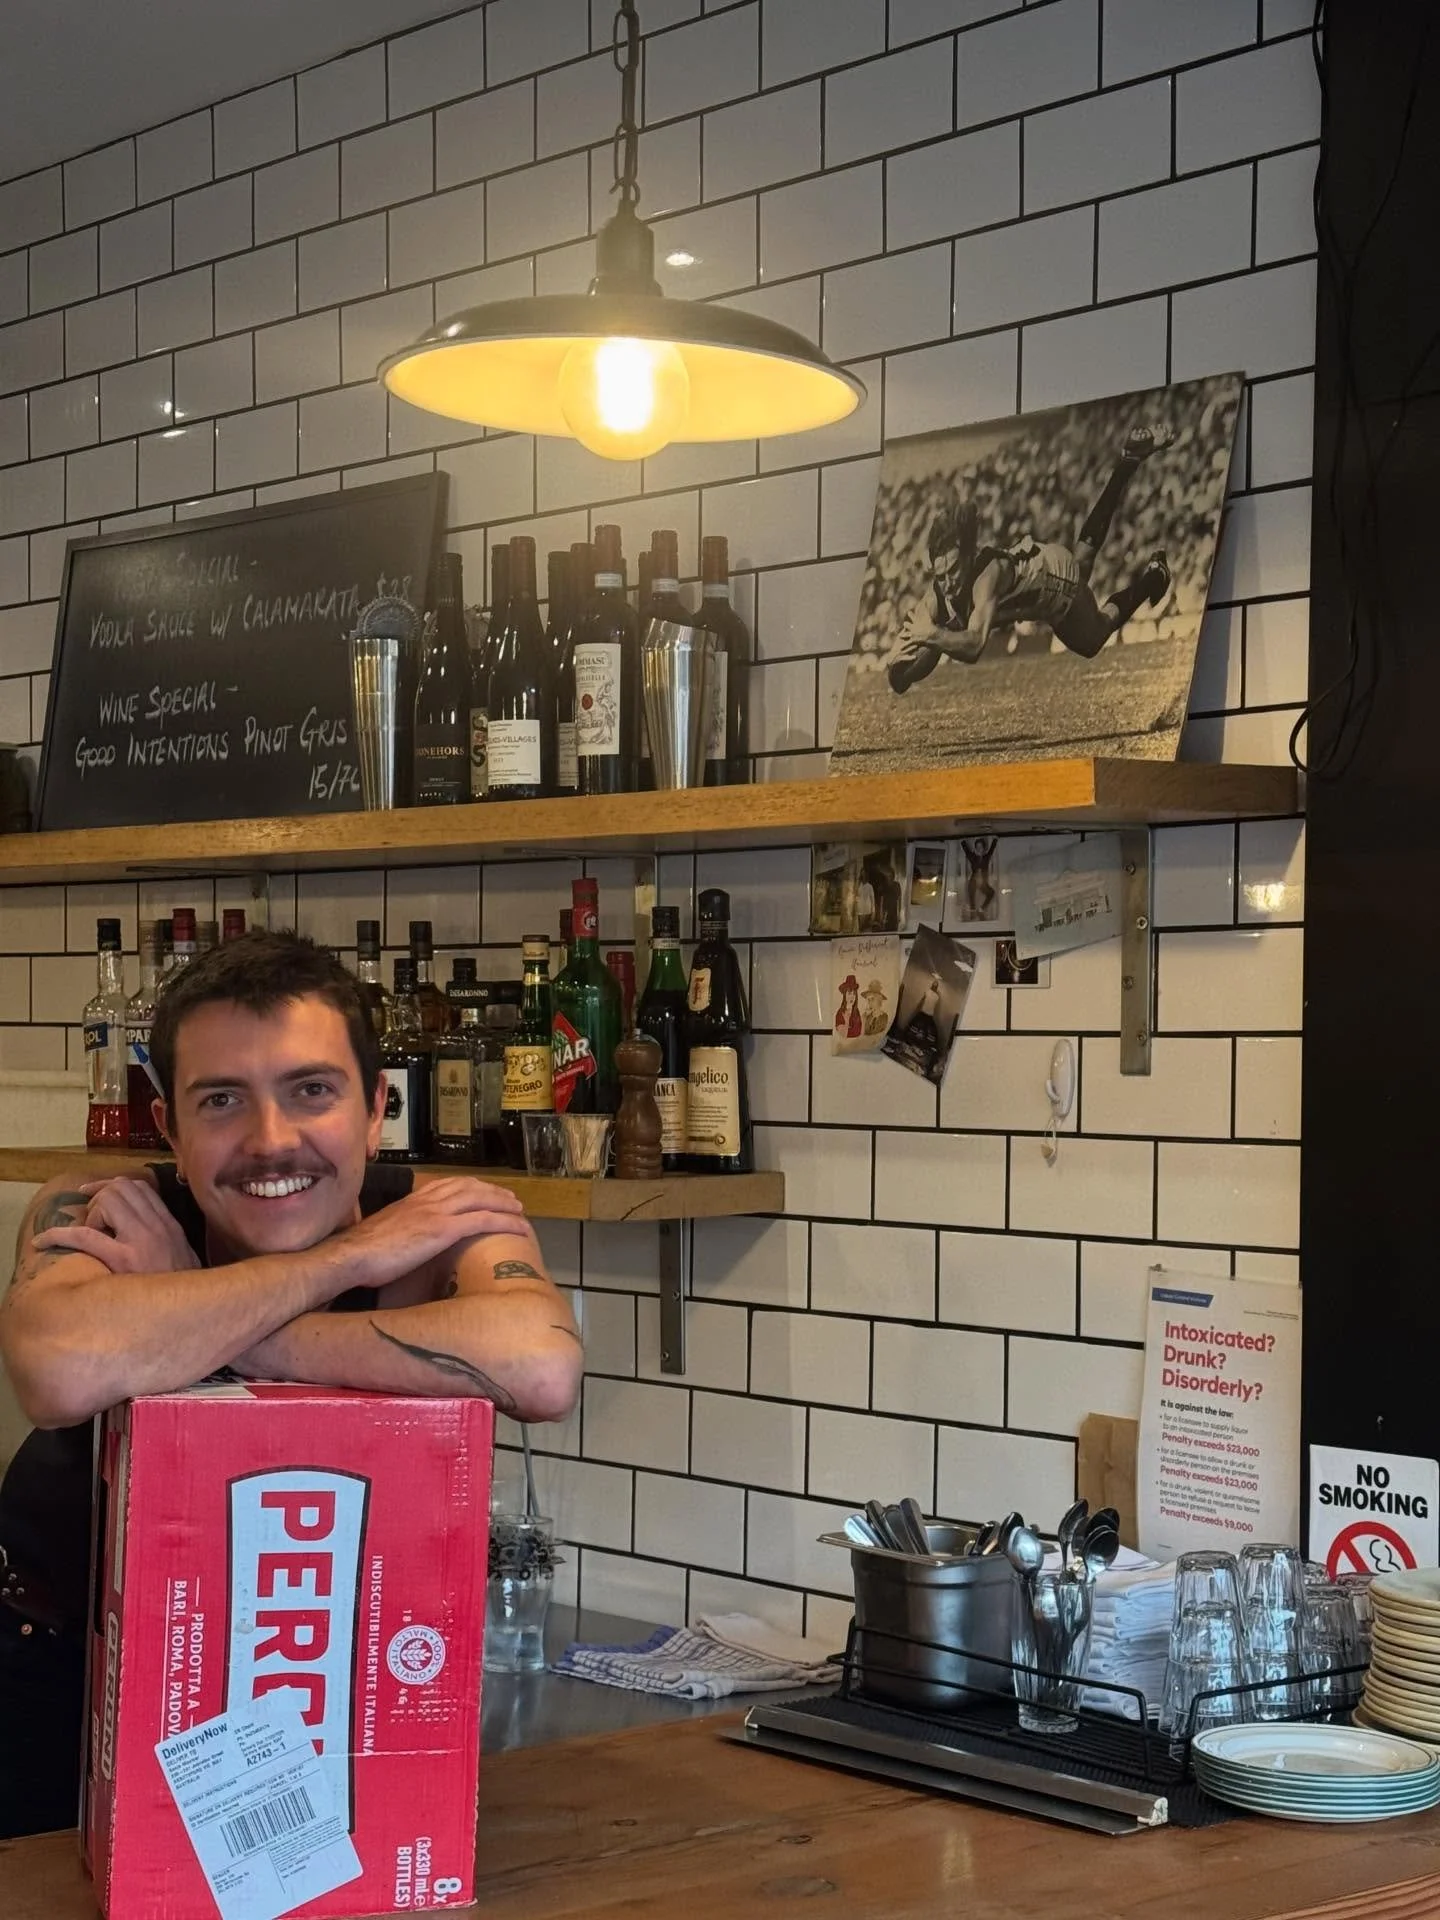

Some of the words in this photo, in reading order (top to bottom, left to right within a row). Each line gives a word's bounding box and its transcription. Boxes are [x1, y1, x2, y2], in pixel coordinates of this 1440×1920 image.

[90, 611, 135, 649] VODKA
[144, 608, 195, 642] SAUCE
[211, 604, 233, 640] W/
[100, 692, 140, 727] WINE
[145, 680, 216, 730] SPECIAL
[76, 736, 116, 780] GOOD
[127, 731, 230, 767] INTENTIONS
[244, 715, 293, 756] PINOT
[300, 706, 347, 756] GRIS
[1165, 1321, 1275, 1352] Intoxicated?
[1164, 1345, 1227, 1370] Drunk?
[1162, 1368, 1263, 1403] Disorderly?
[1175, 1402, 1203, 1413] against
[1205, 1406, 1217, 1415] the
[1219, 1408, 1233, 1418] law:
[1162, 1433, 1192, 1447] Penalty
[1194, 1439, 1225, 1451] exceeds
[1227, 1443, 1260, 1457] $23,000
[1160, 1465, 1191, 1479] Penalty
[1192, 1471, 1223, 1484] exceeds
[1225, 1477, 1258, 1491] $23,000
[1357, 1464, 1390, 1488] NO
[1319, 1483, 1429, 1519] SMOKING
[1160, 1507, 1190, 1521] Penalty
[1192, 1513, 1223, 1526] exceeds
[1225, 1520, 1253, 1532] $9,000
[170, 1579, 187, 1622] BARI,
[365, 1554, 384, 1691] INDISCUTIBILMENTE
[168, 1625, 185, 1678] ROMA,
[188, 1612, 205, 1692] PRODOTTA
[187, 1698, 201, 1710] A
[161, 1722, 228, 1761] DeliveryNow
[360, 1694, 376, 1757] ITALIANA
[246, 1750, 273, 1768] A2743
[414, 1835, 432, 1876] (3x330
[393, 1845, 413, 1908] BOTTLES)
[432, 1877, 463, 1905] 8x
